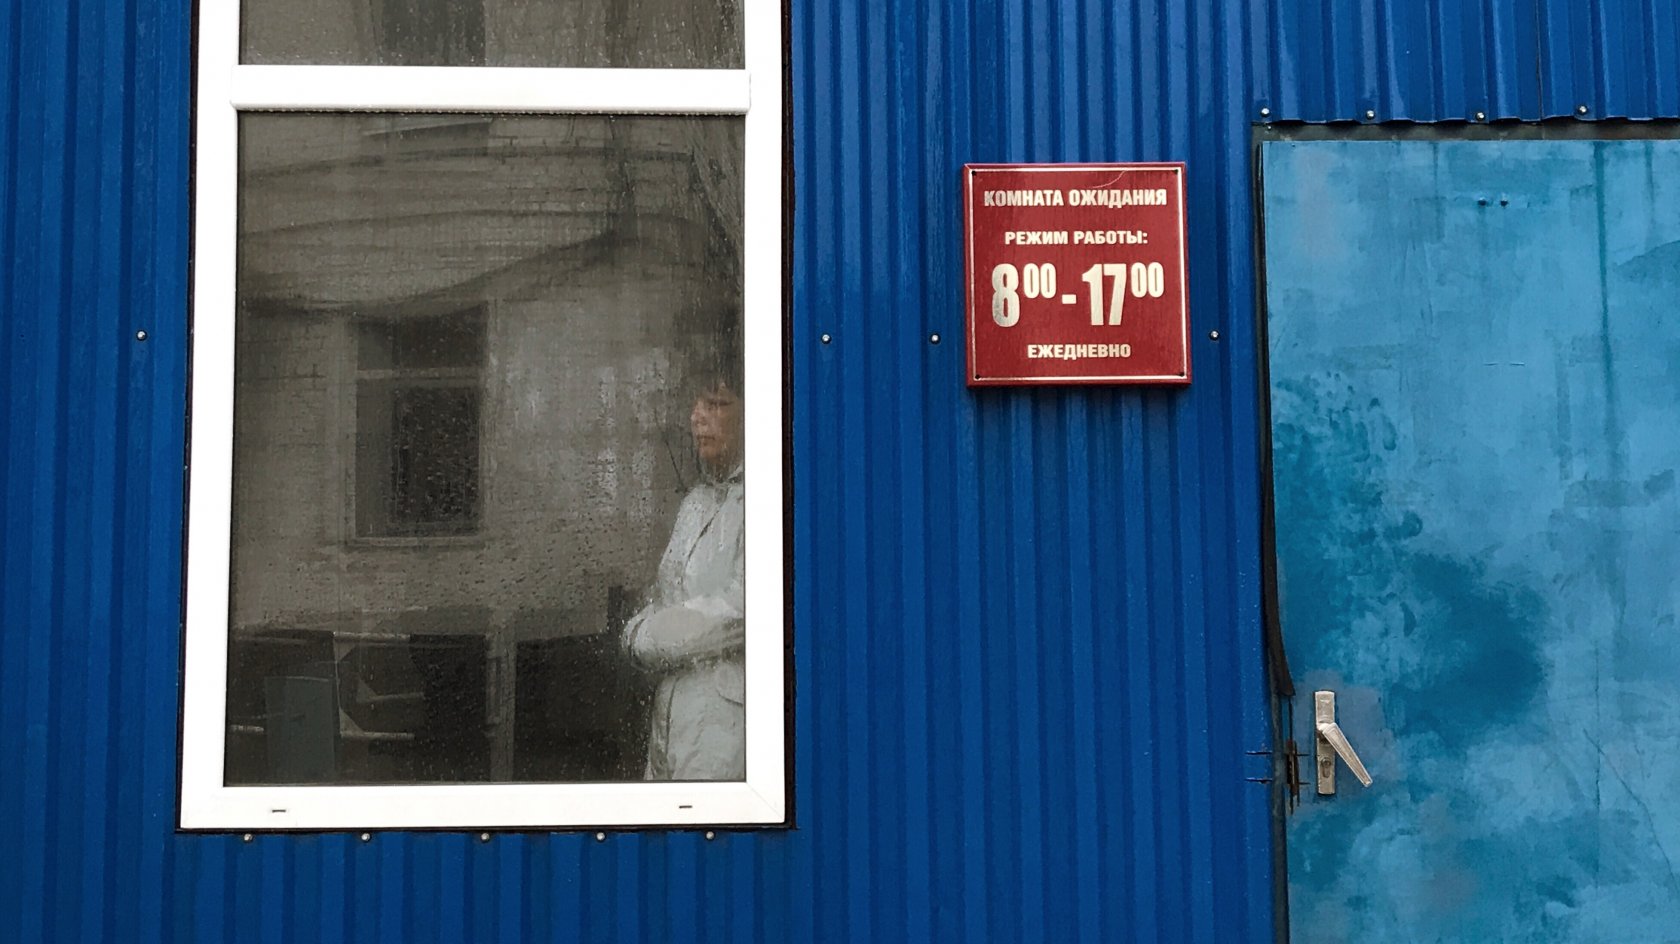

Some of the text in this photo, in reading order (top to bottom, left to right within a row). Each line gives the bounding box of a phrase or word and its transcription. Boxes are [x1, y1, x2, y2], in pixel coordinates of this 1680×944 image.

[984, 189, 1167, 208] КОМНАТА ОЖИДАНИЯ
[1005, 230, 1148, 245] РЕЖИМ РАБОТЫ:
[1027, 344, 1131, 360] ЕЖЕДНЕВНО
